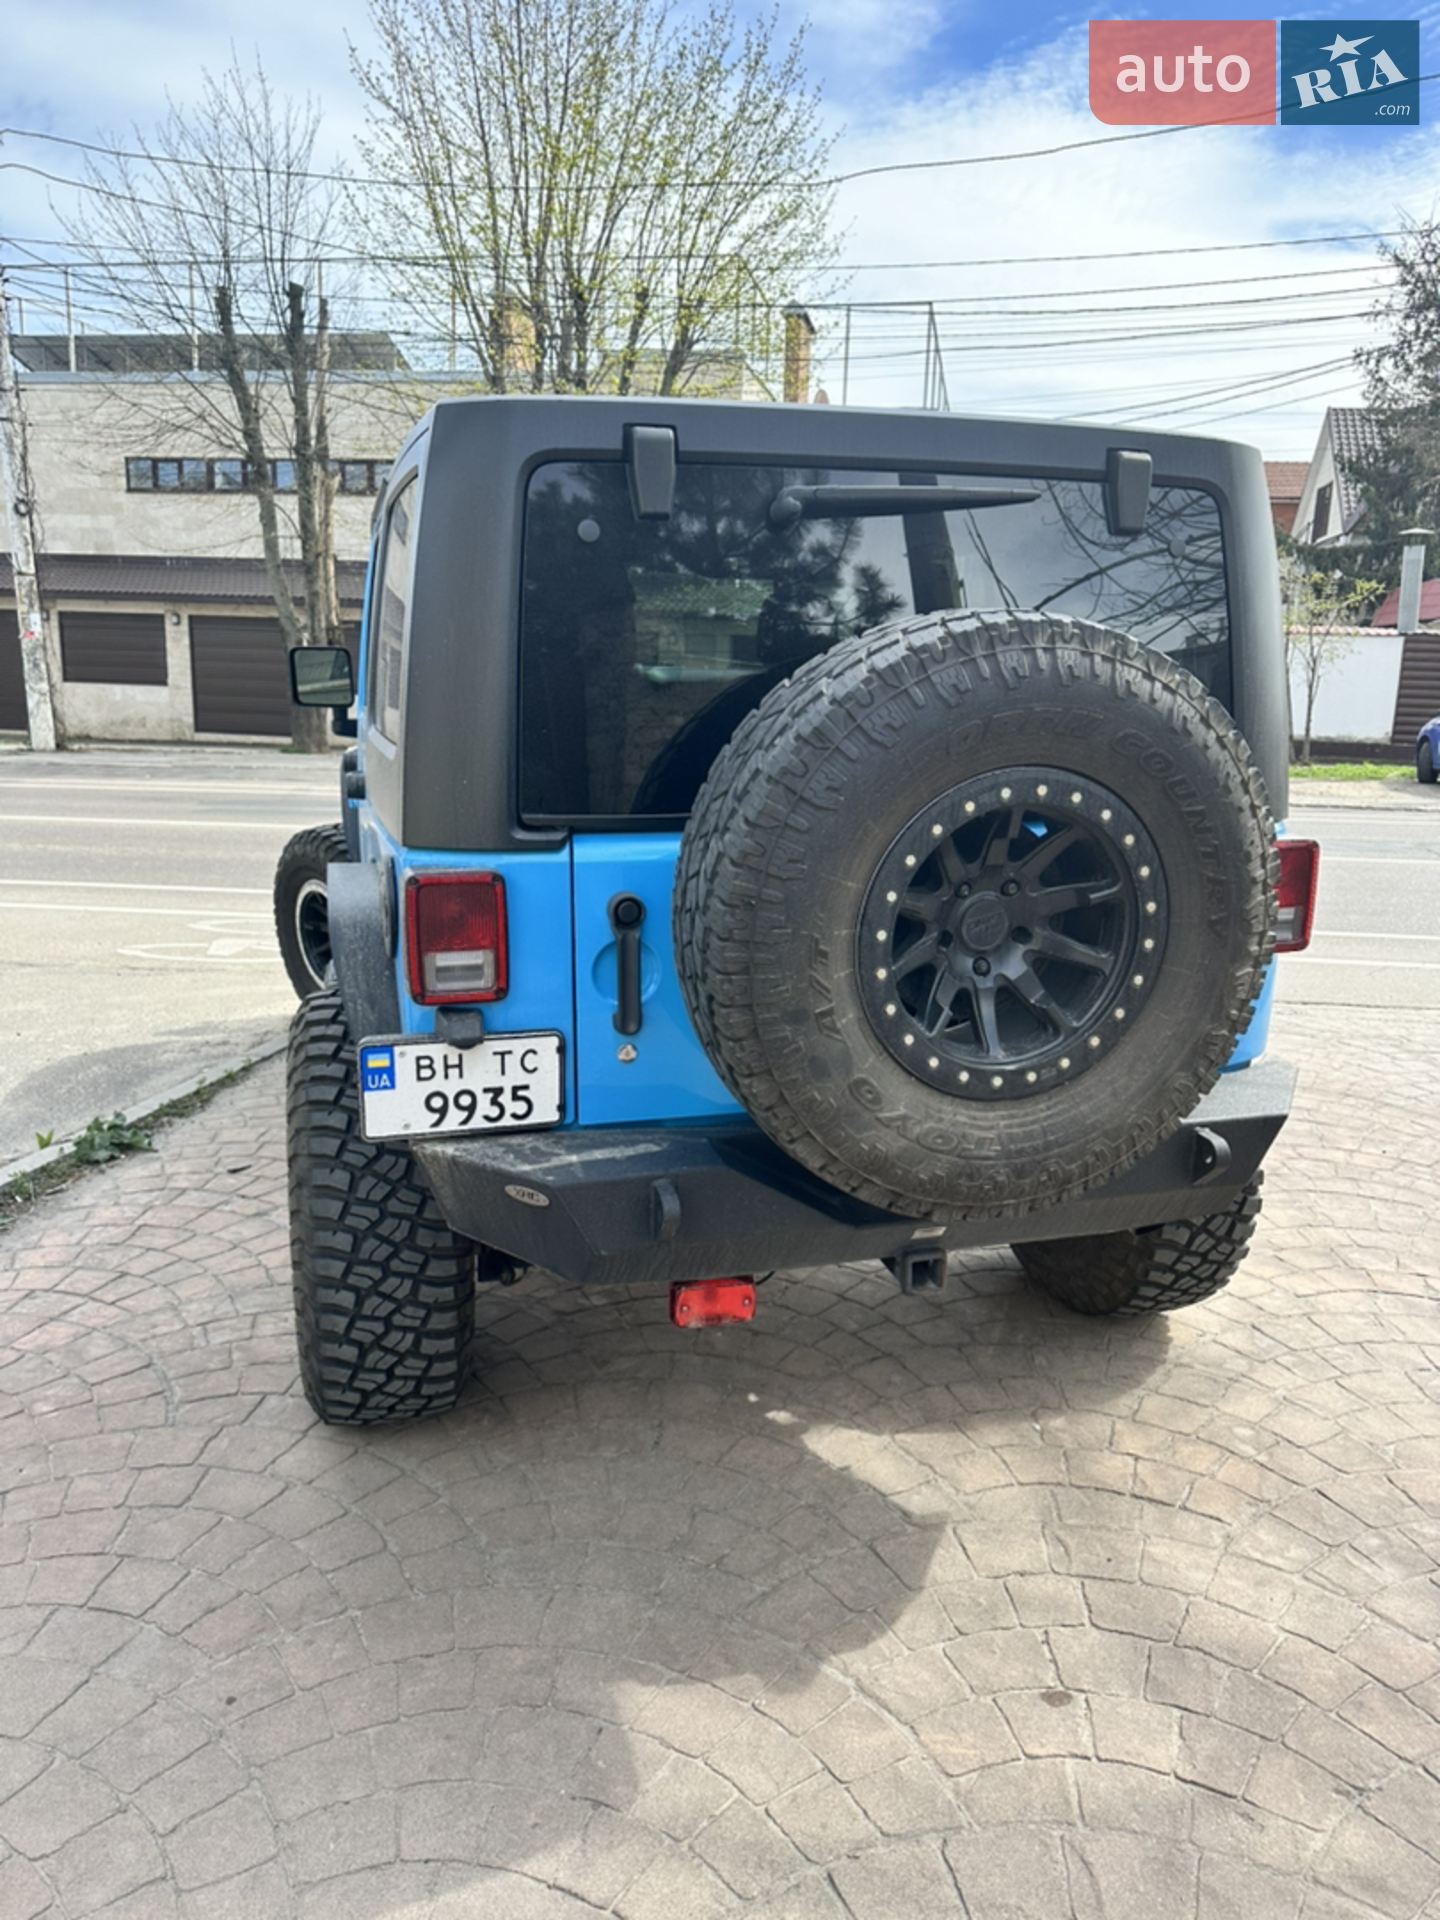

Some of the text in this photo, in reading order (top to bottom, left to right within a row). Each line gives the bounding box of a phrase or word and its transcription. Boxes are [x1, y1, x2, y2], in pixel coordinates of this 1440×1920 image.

[1110, 727, 1228, 942] COUNTRY
[367, 1073, 392, 1089] UA
[415, 1049, 539, 1082] BH TC
[423, 1084, 534, 1129] 9935
[847, 1073, 1003, 1160] TOYO
